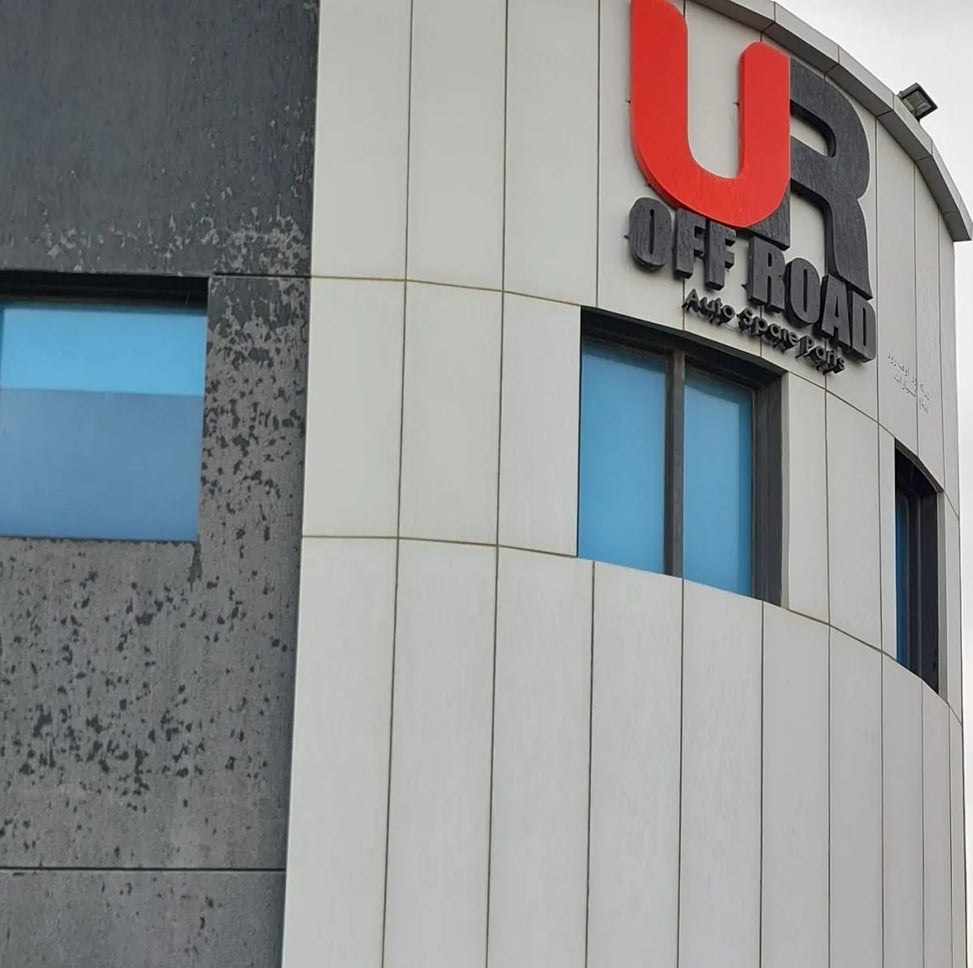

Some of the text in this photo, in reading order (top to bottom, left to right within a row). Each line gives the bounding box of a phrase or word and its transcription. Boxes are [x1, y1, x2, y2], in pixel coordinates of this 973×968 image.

[629, 197, 877, 362] OFF ROAD
[683, 288, 735, 326] Auto
[738, 307, 799, 353] Spare
